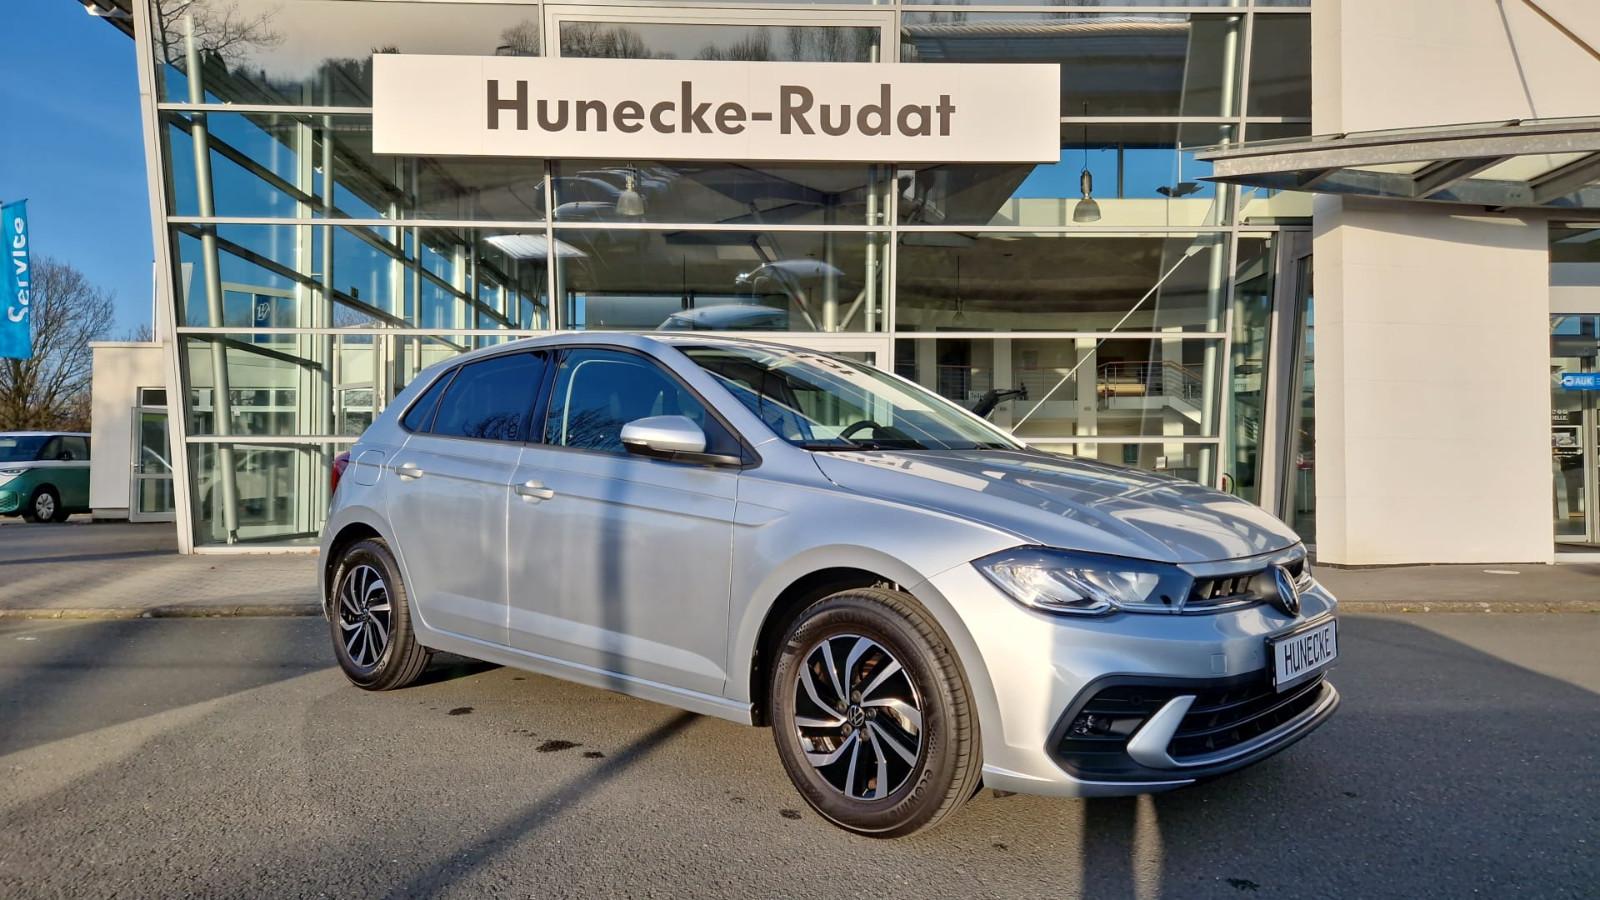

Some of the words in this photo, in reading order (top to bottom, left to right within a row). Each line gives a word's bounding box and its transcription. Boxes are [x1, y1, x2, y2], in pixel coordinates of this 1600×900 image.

[487, 79, 956, 136] Hunecke-Rudat
[8, 217, 29, 323] Service
[1284, 628, 1331, 676] HUNECKE
